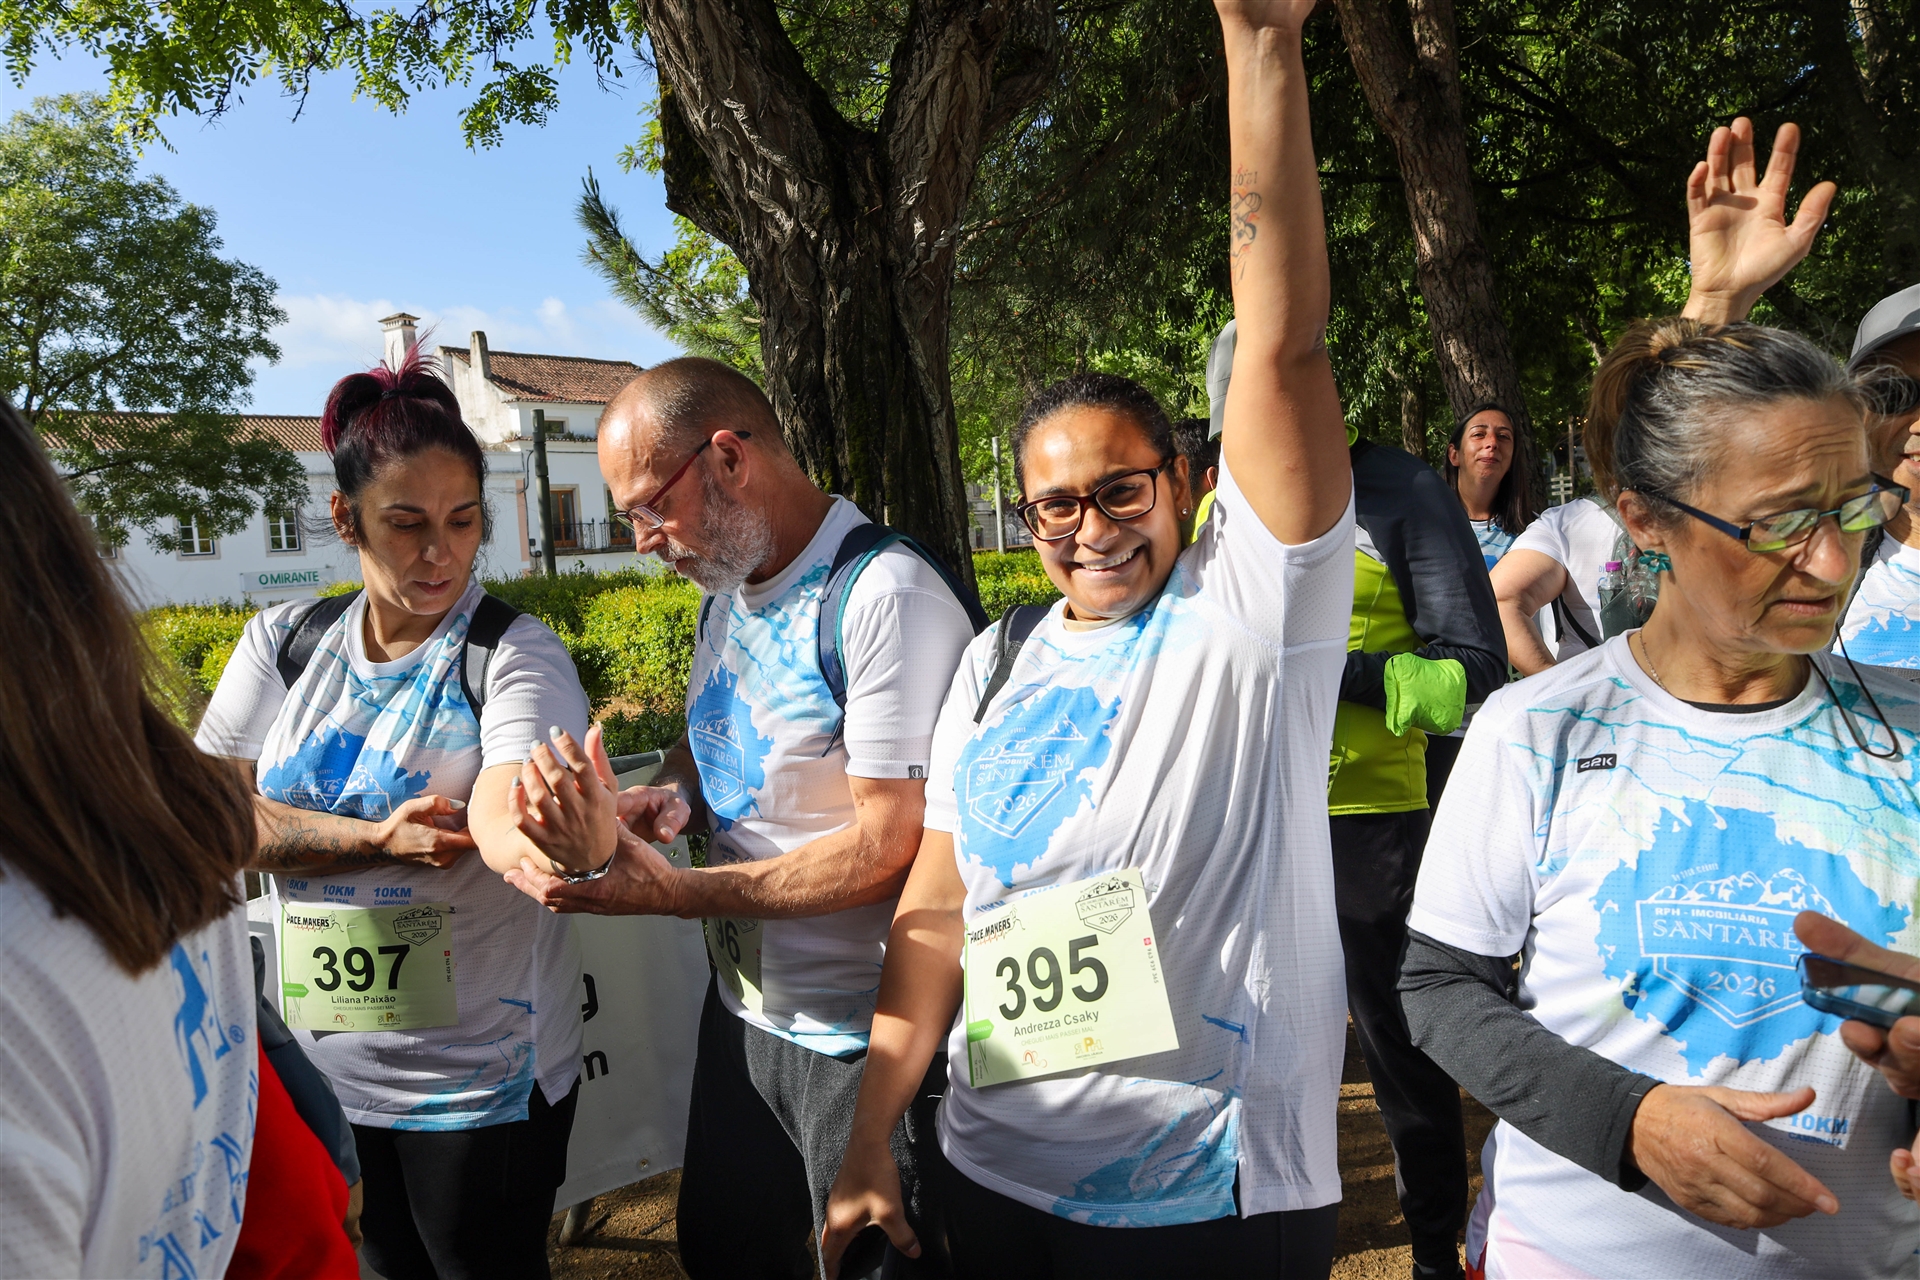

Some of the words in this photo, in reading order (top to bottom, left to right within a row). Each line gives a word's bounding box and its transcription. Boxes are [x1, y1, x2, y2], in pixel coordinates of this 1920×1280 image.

[258, 574, 269, 585] O
[270, 571, 319, 585] MIRANTE
[695, 741, 738, 769] SANTARÉM
[708, 775, 728, 793] 2026
[994, 792, 1036, 817] 2026
[323, 885, 355, 896] 10KM
[374, 887, 412, 898] 10KM
[1080, 895, 1130, 913] SANTARÉM
[397, 919, 438, 929] SANTARÉM
[1099, 913, 1119, 925] 2026
[1655, 907, 1681, 916] RPH
[1691, 909, 1769, 926] IMOBILIÁRIA
[411, 931, 428, 939] 2026
[985, 918, 1011, 936] MAKERS
[1652, 919, 1807, 952] SANTARÉ
[312, 944, 410, 992] 397
[995, 933, 1109, 1021] 395
[1706, 971, 1777, 999] 2026
[331, 995, 361, 1004] Liliana
[363, 995, 396, 1004] Paixão
[1013, 1018, 1061, 1038] Andrezza
[1063, 1010, 1099, 1026] Csaky
[1021, 1036, 1045, 1046] CHEGUEI
[1045, 1033, 1060, 1041] MAIS
[1060, 1029, 1081, 1038] PASSEI
[1081, 1026, 1094, 1034] MAL
[1789, 1113, 1848, 1135] 10KM
